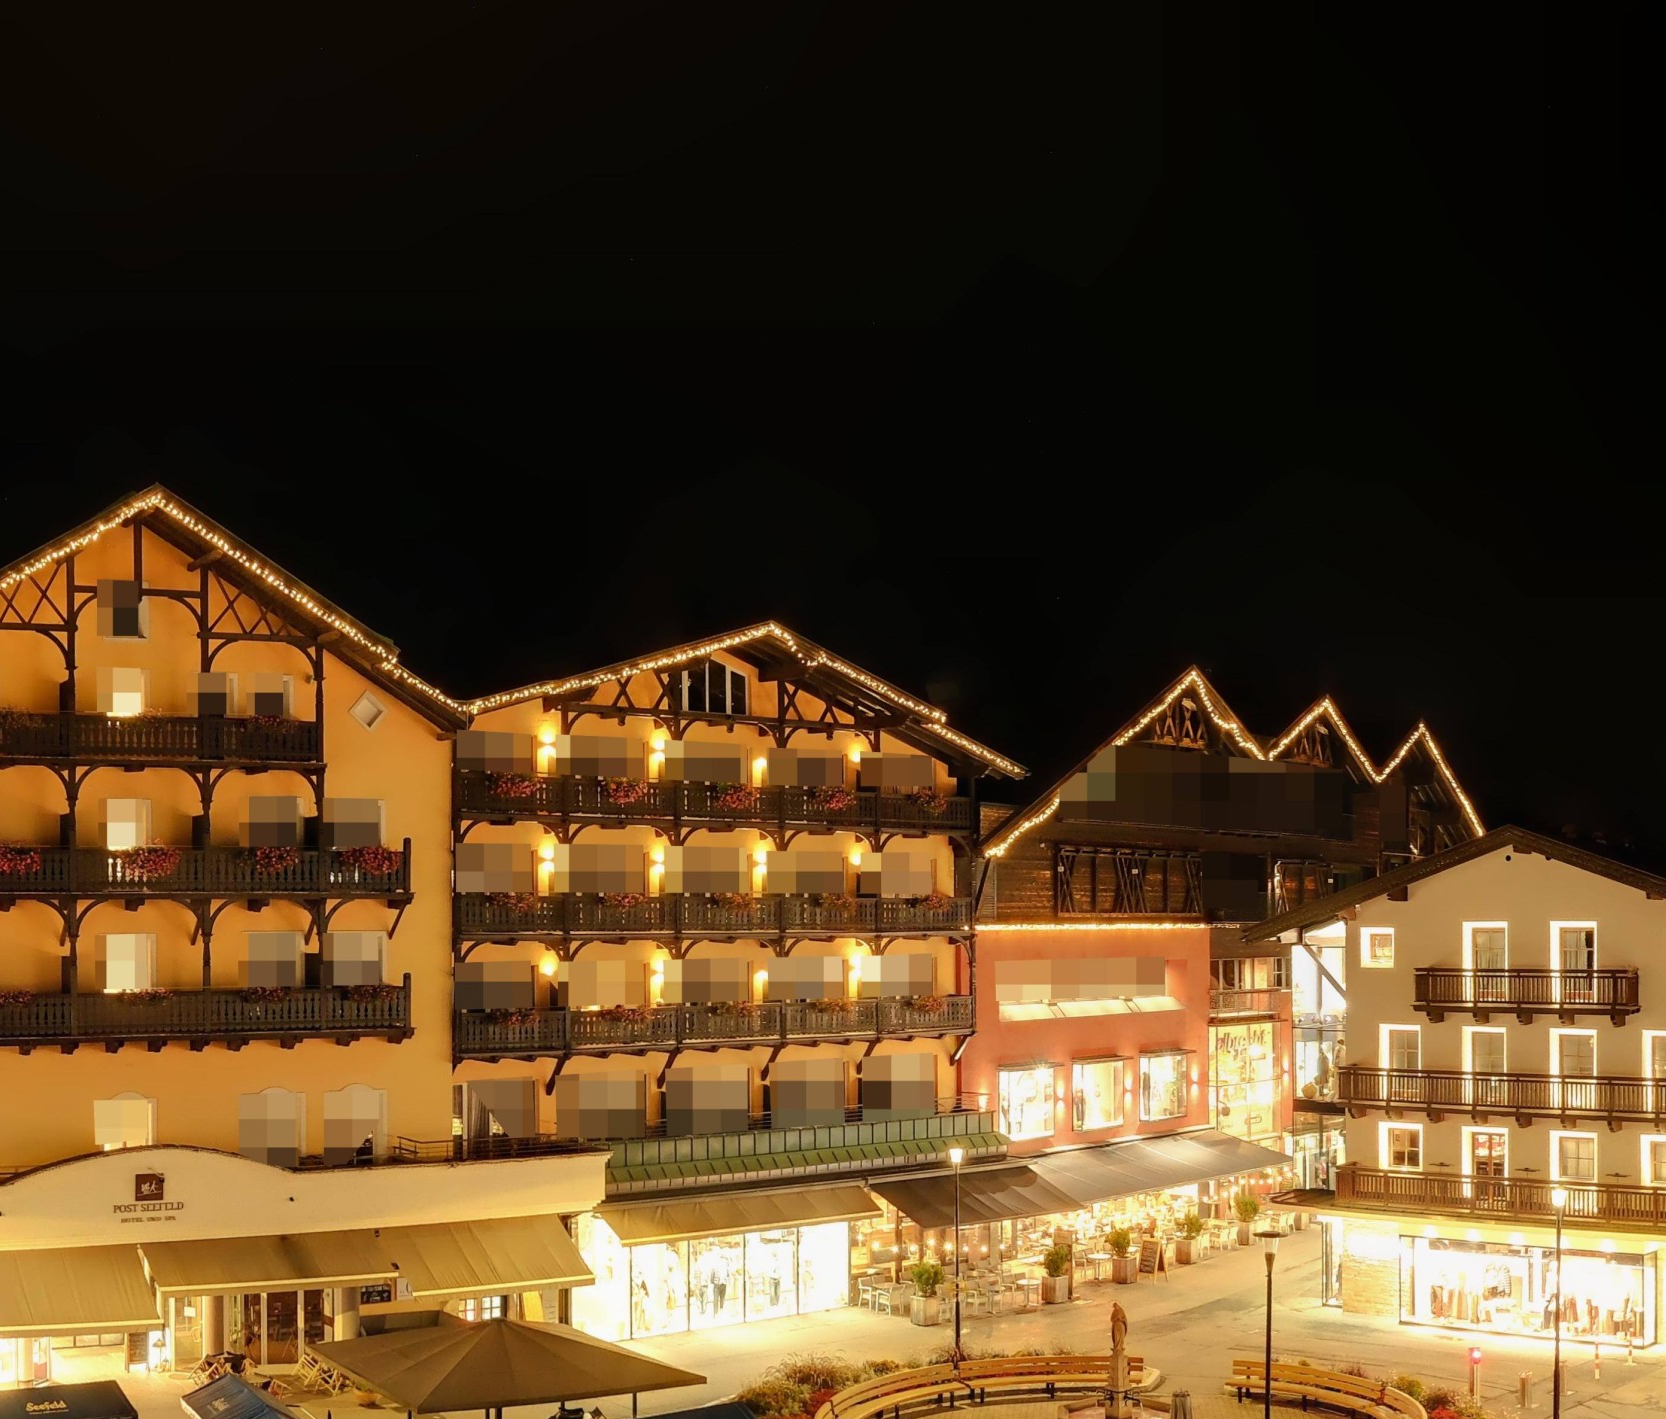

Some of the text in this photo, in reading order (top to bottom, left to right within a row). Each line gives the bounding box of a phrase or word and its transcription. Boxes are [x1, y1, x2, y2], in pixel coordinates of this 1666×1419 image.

[113, 1201, 184, 1214] POST SEEFELD
[25, 1399, 68, 1411] Seefeld
